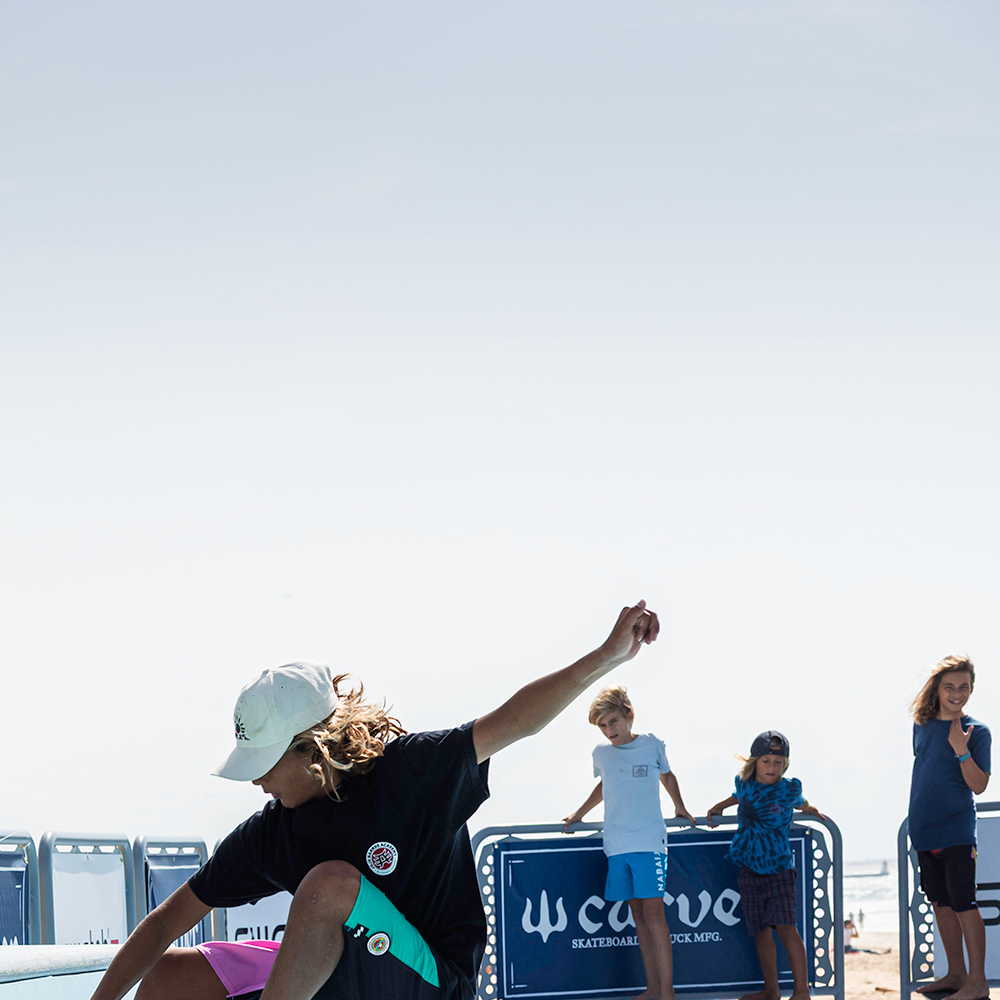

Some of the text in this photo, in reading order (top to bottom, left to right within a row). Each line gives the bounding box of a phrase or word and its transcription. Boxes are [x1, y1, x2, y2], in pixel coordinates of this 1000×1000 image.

[578, 888, 742, 934] cave
[670, 933, 694, 944] UCK
[694, 932, 723, 943] MFG.
